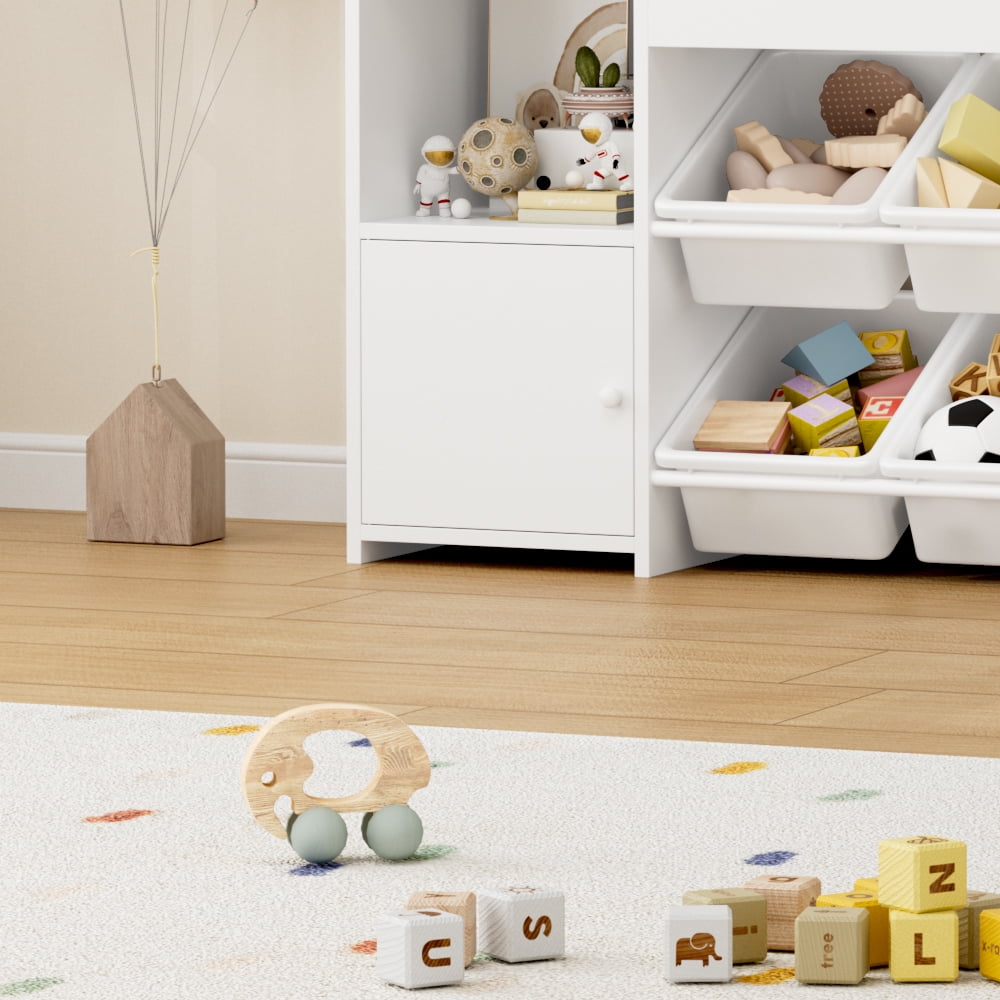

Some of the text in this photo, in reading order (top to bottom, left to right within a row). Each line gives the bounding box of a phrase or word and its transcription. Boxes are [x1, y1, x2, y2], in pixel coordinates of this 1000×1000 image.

[522, 915, 552, 941] S
[422, 938, 451, 968] U
[821, 932, 834, 969] tree
[914, 933, 936, 966] L
